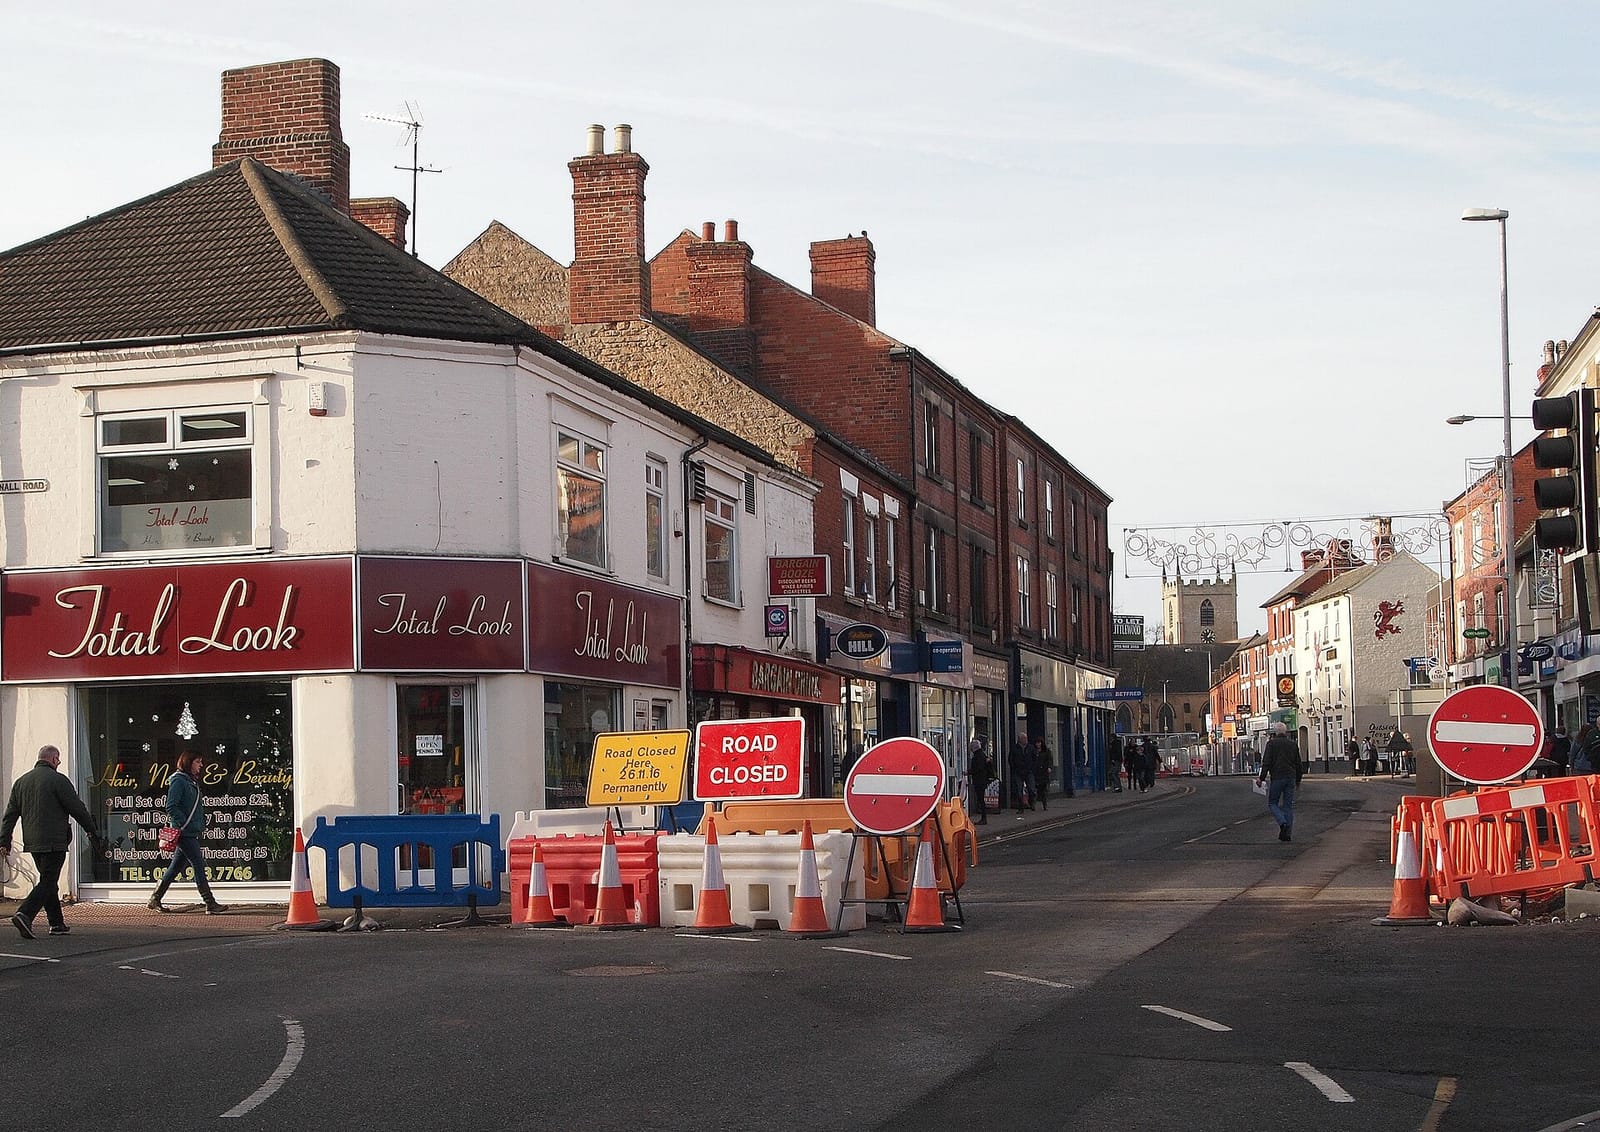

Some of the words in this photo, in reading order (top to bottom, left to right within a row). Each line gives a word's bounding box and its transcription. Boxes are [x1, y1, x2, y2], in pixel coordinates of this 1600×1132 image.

[22, 481, 45, 490] ROAD
[146, 506, 178, 527] Total
[178, 505, 209, 525] Look
[775, 559, 819, 568] BARGAIN
[780, 569, 815, 578] BOOZE
[48, 582, 175, 659] Total
[179, 577, 297, 655] Look
[374, 592, 447, 634] Total
[448, 594, 513, 635] Look
[574, 590, 614, 660] Total
[614, 600, 649, 665] Look
[848, 640, 875, 653] HILL
[1527, 646, 1550, 658] Boots
[751, 660, 793, 694] BARGAIN
[721, 734, 778, 753] ROAD
[605, 748, 633, 759] Road
[637, 745, 677, 757] Closed
[626, 759, 651, 769] Here
[203, 763, 228, 785] &
[233, 761, 292, 790] Beauty
[619, 767, 660, 780] 26.11.16
[709, 764, 788, 785] CLOSED
[602, 781, 668, 794] Permanently
[114, 795, 133, 808] Full
[135, 795, 153, 808] Set
[154, 794, 167, 808] of
[202, 794, 247, 807] tensions
[131, 812, 151, 824] Full
[213, 811, 232, 823] Tan
[234, 810, 252, 823] £15
[138, 828, 157, 840] Full
[113, 848, 159, 863] Eyebrow
[254, 847, 268, 859] £5
[120, 867, 151, 881] TEL:
[216, 867, 253, 881] 7766
